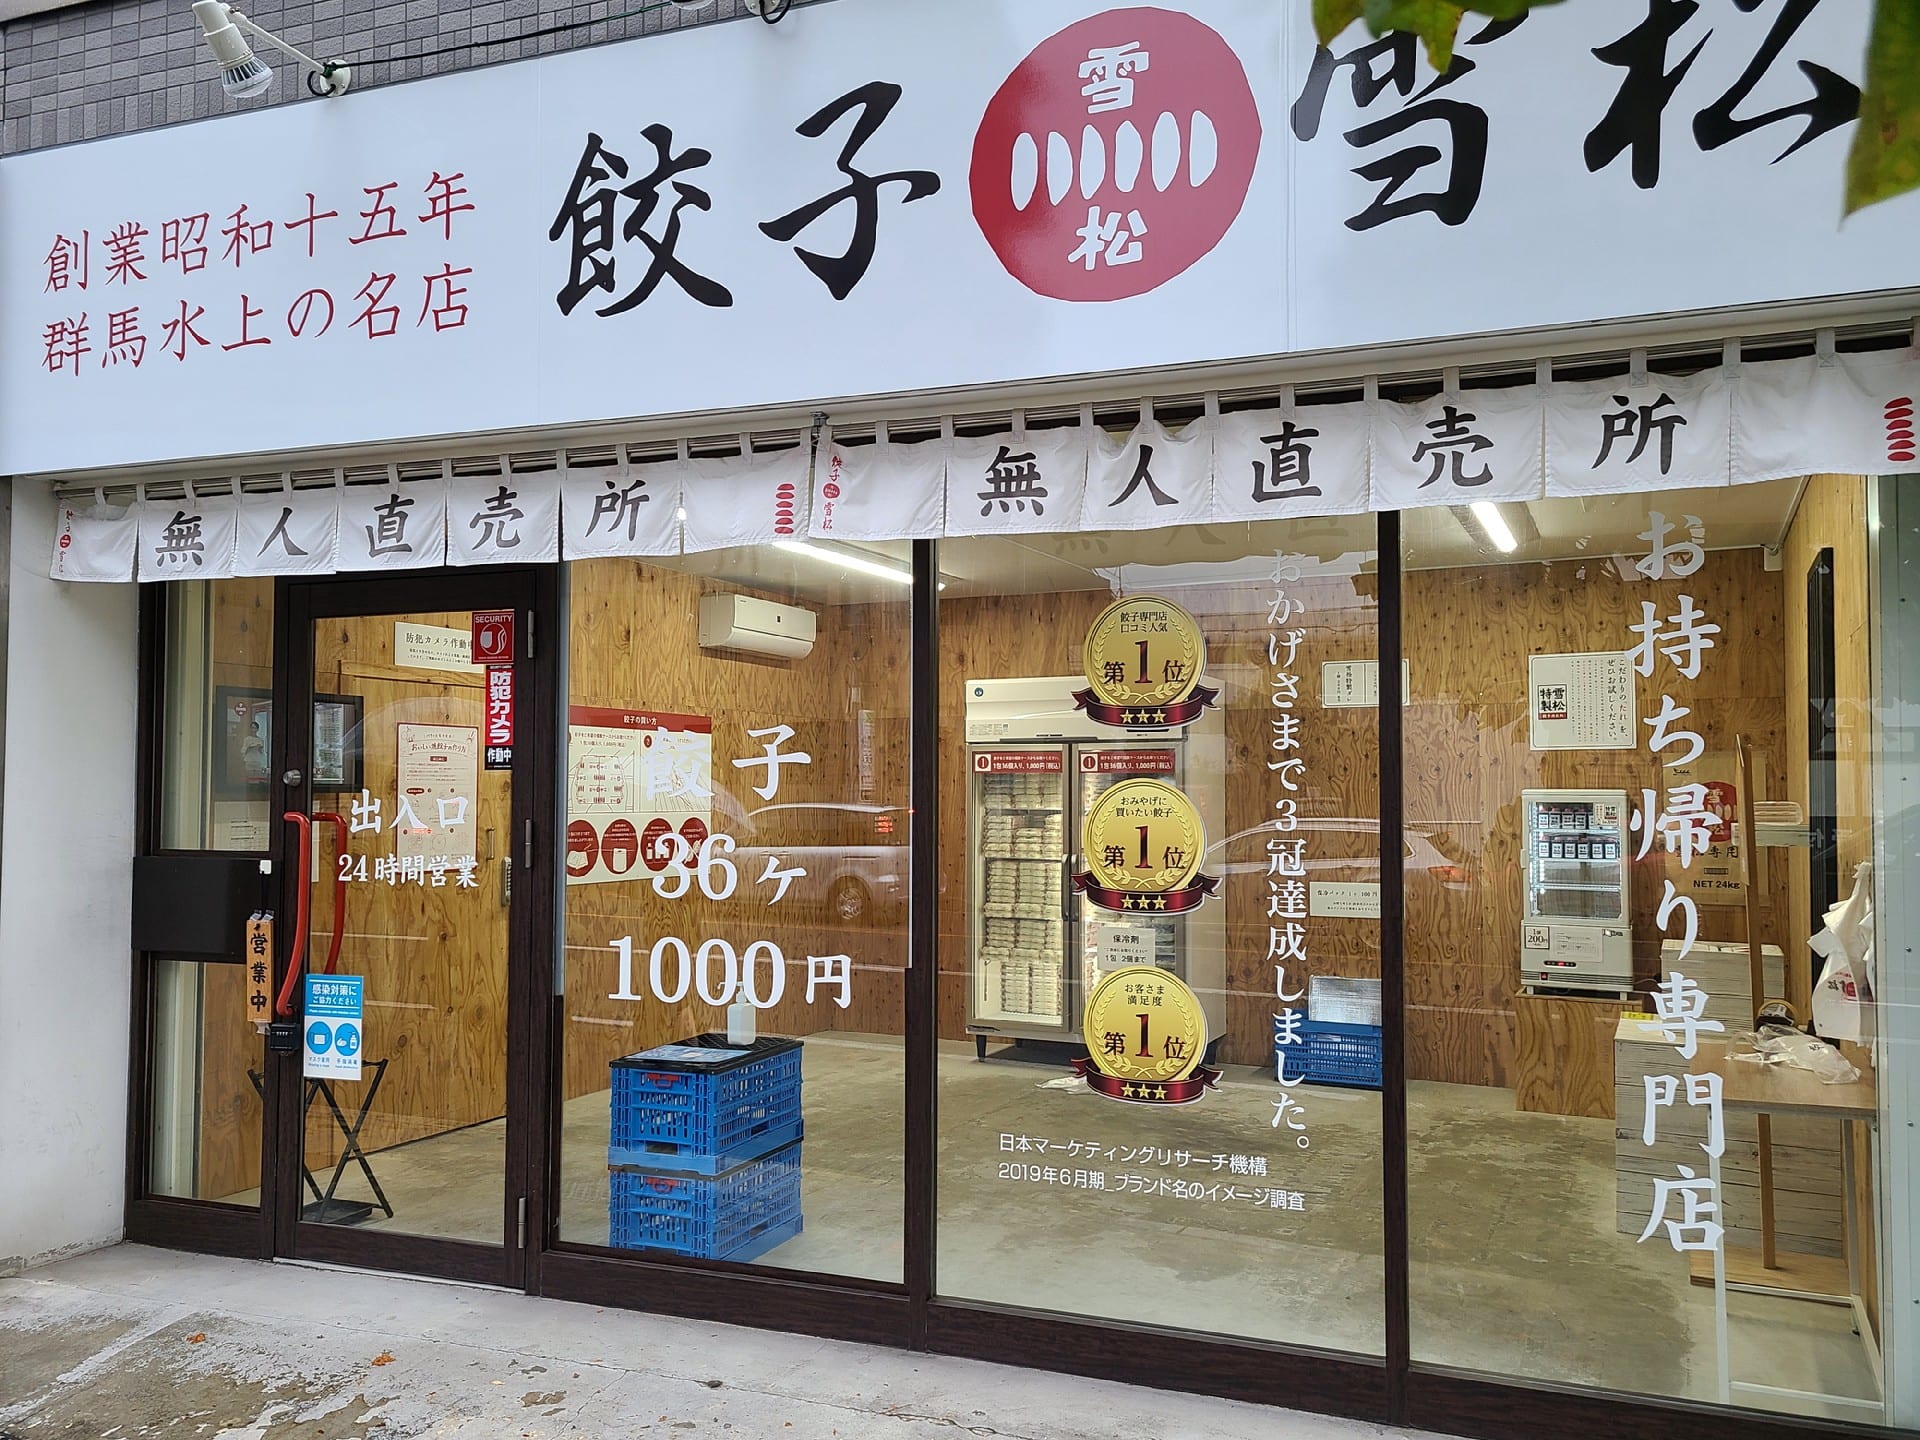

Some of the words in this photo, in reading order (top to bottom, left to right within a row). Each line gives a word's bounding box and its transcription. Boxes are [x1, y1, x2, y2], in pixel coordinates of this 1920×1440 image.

[1079, 41, 1149, 114] 雪
[1290, 0, 1863, 230] 雪松
[548, 80, 941, 318] 餃子
[42, 171, 475, 294] 創業昭和十五年
[1067, 205, 1148, 271] 松
[41, 262, 473, 377] 群馬水上の名店
[977, 394, 1687, 518] 無人直売所
[155, 480, 649, 568] 無人直売所
[475, 615, 512, 624] SECURITY
[1120, 611, 1167, 623] 餃子専門店
[1120, 622, 1168, 634] 口コミ人気
[1103, 639, 1186, 685] 第1位
[489, 671, 512, 744] 防犯カメラ
[487, 747, 512, 764] 作動中
[645, 723, 812, 801] 餃子
[349, 788, 469, 835] 出入口
[1115, 807, 1173, 818] 買いたい餃子
[1120, 796, 1167, 807] おみやげに
[337, 853, 481, 889] 24時間営業
[1103, 825, 1186, 870] 第1位
[1266, 547, 1310, 1150] おかげさまで3冠達成しました。
[1625, 511, 1725, 1252] お持ち帰り専門店
[1693, 880, 1713, 888] NET
[1716, 880, 1740, 889] 24kg
[250, 932, 268, 1012] 営業中
[312, 983, 357, 996] 感染対策に
[607, 935, 852, 1009] 1000円
[1124, 982, 1165, 995] お客さま
[1127, 994, 1163, 1007] 満足度
[1103, 1013, 1187, 1061] 第1位
[999, 1133, 1268, 1177] 日本マーケティングリサーチ機構
